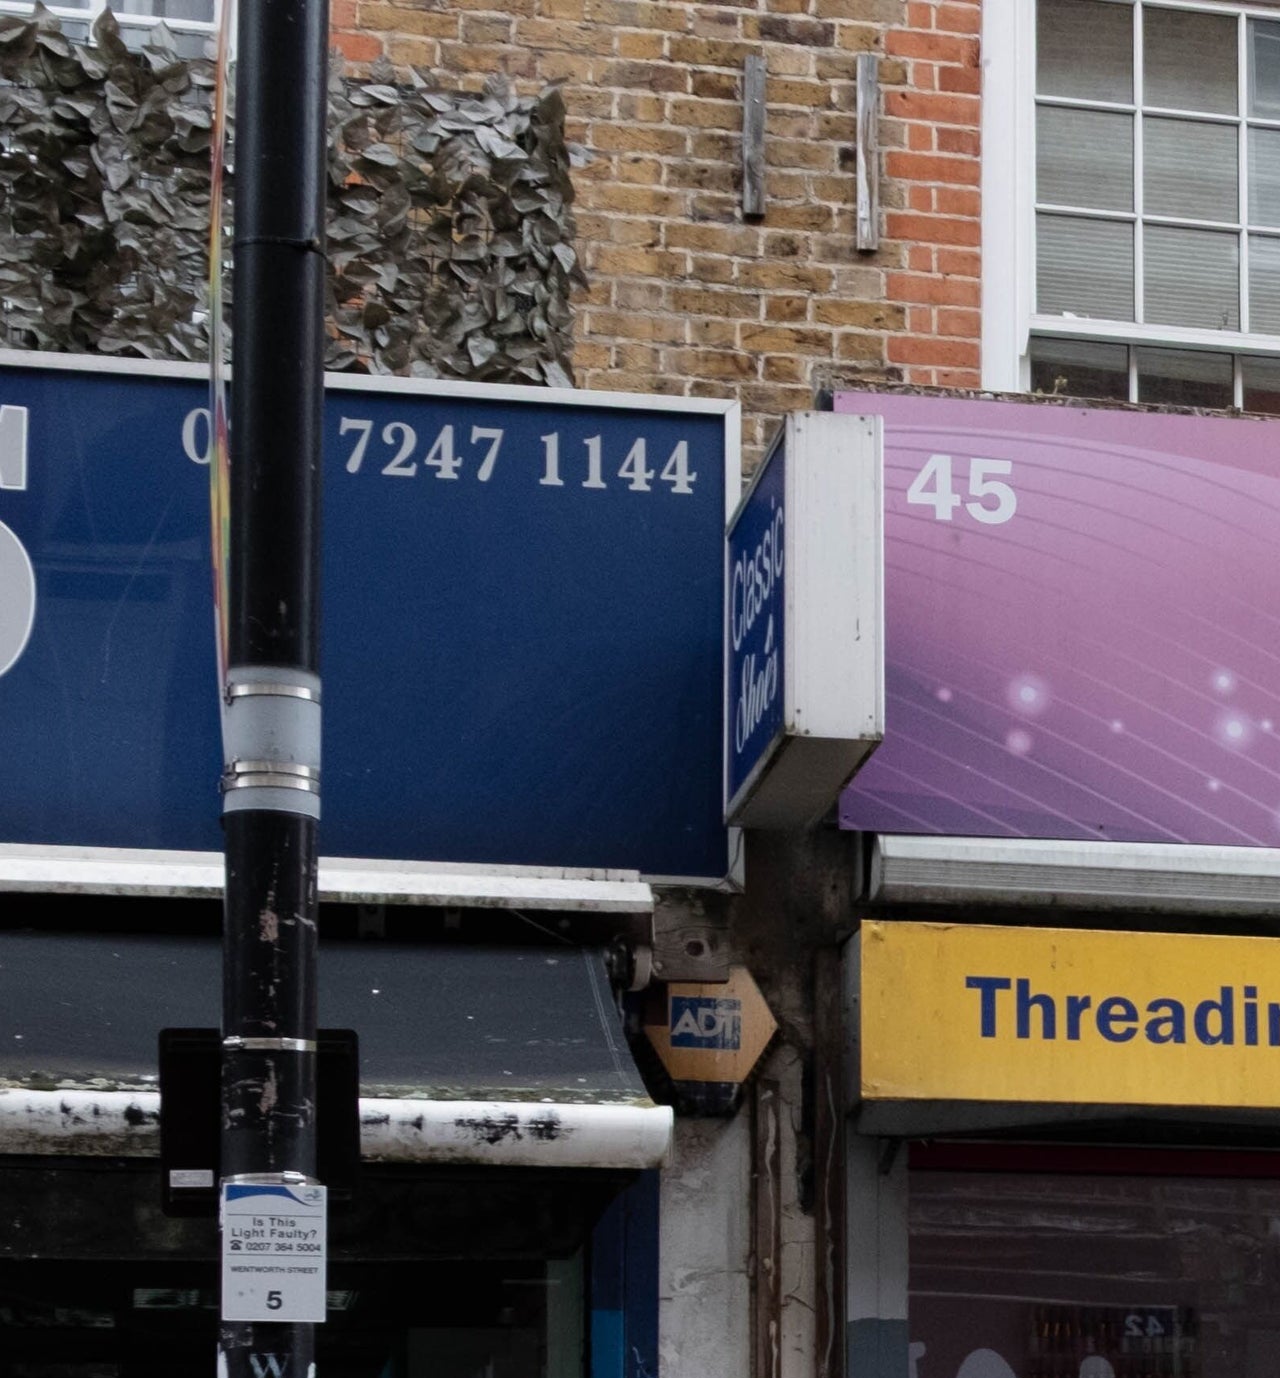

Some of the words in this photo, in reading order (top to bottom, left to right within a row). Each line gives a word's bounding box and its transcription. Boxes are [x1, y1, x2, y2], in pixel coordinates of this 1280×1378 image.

[339, 417, 503, 482] 7247
[539, 434, 697, 494] 1144
[907, 455, 1017, 526] 45
[731, 496, 784, 653] Classic
[671, 1006, 741, 1039] ADT
[231, 1229, 265, 1239] Light
[270, 1229, 317, 1240] Faulty?
[252, 1217, 264, 1227] Is
[269, 1217, 296, 1227] This
[245, 1242, 271, 1251] 0207
[266, 1290, 283, 1310] 5
